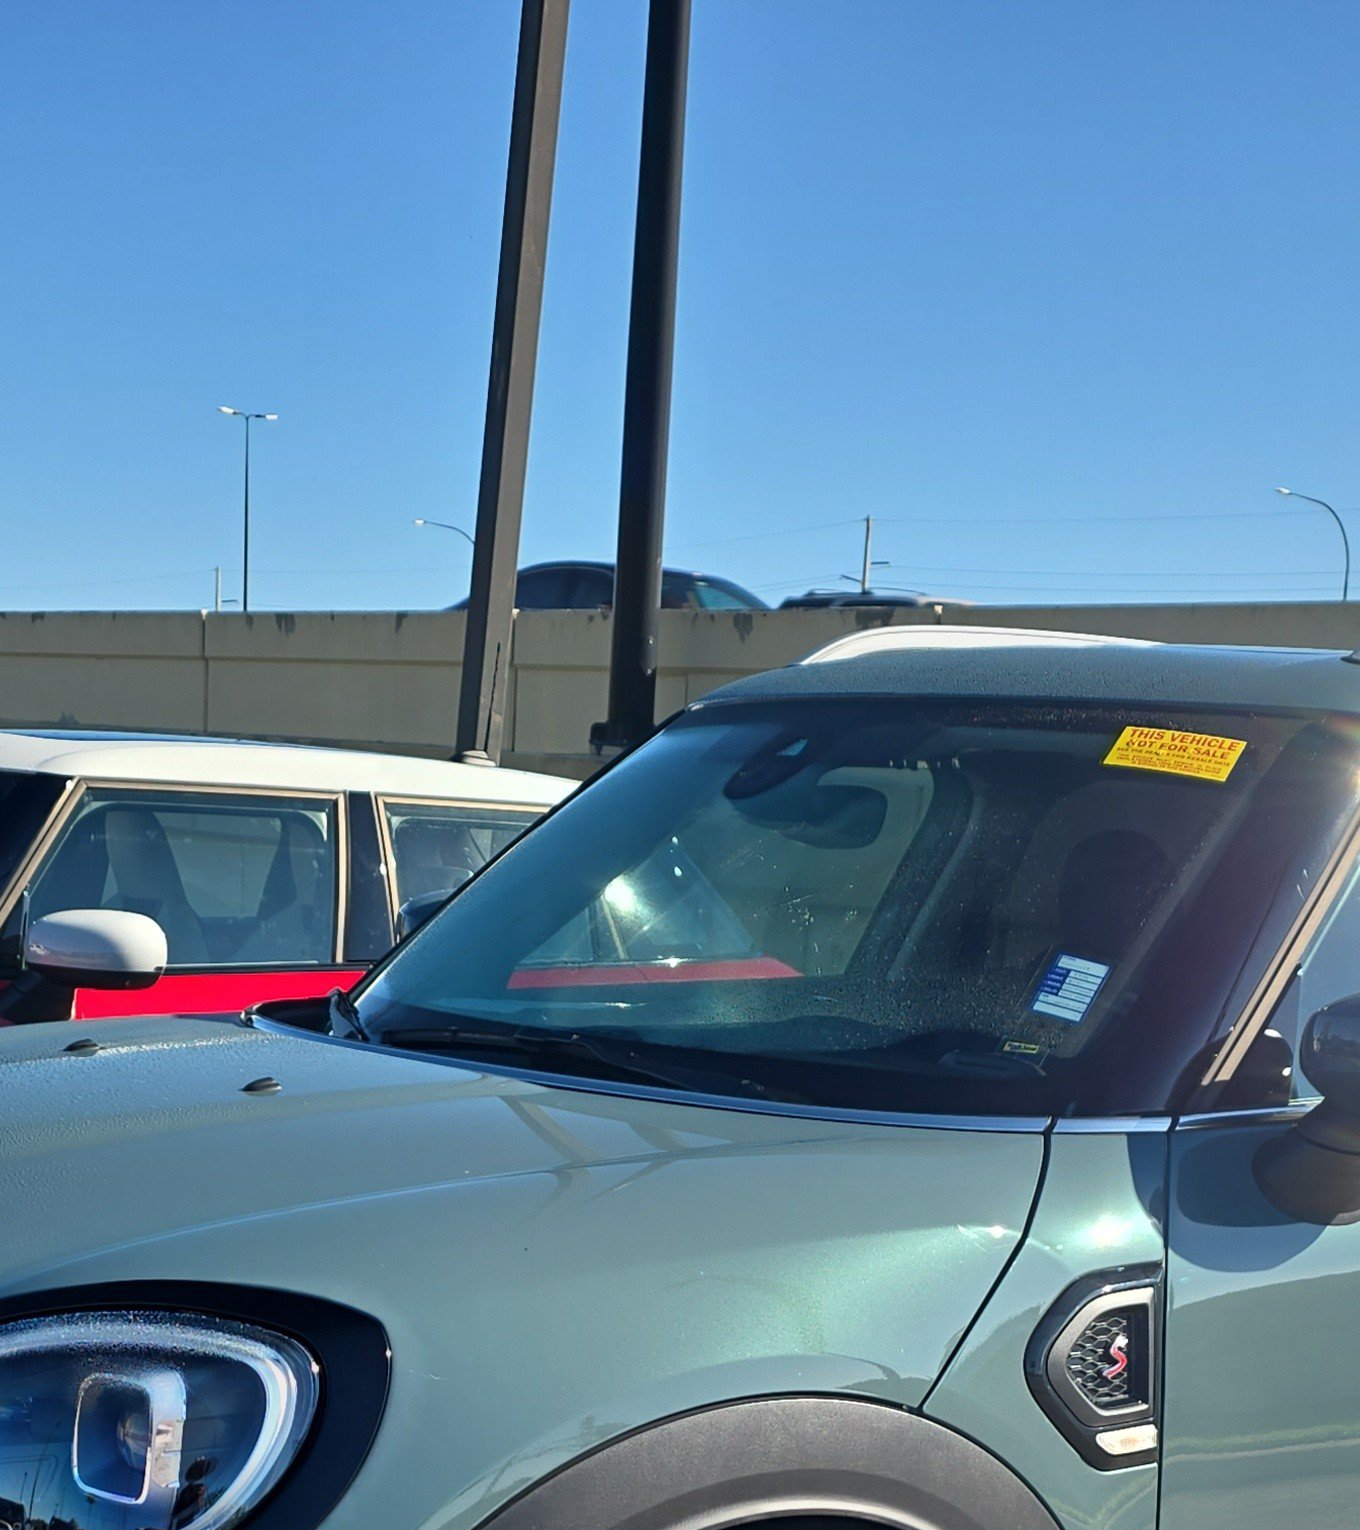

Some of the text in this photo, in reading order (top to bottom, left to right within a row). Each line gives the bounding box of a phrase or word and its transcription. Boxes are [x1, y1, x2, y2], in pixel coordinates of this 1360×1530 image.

[1125, 738, 1231, 760] NOT FOR SALE
[1129, 728, 1240, 752] THIS VEHICLE
